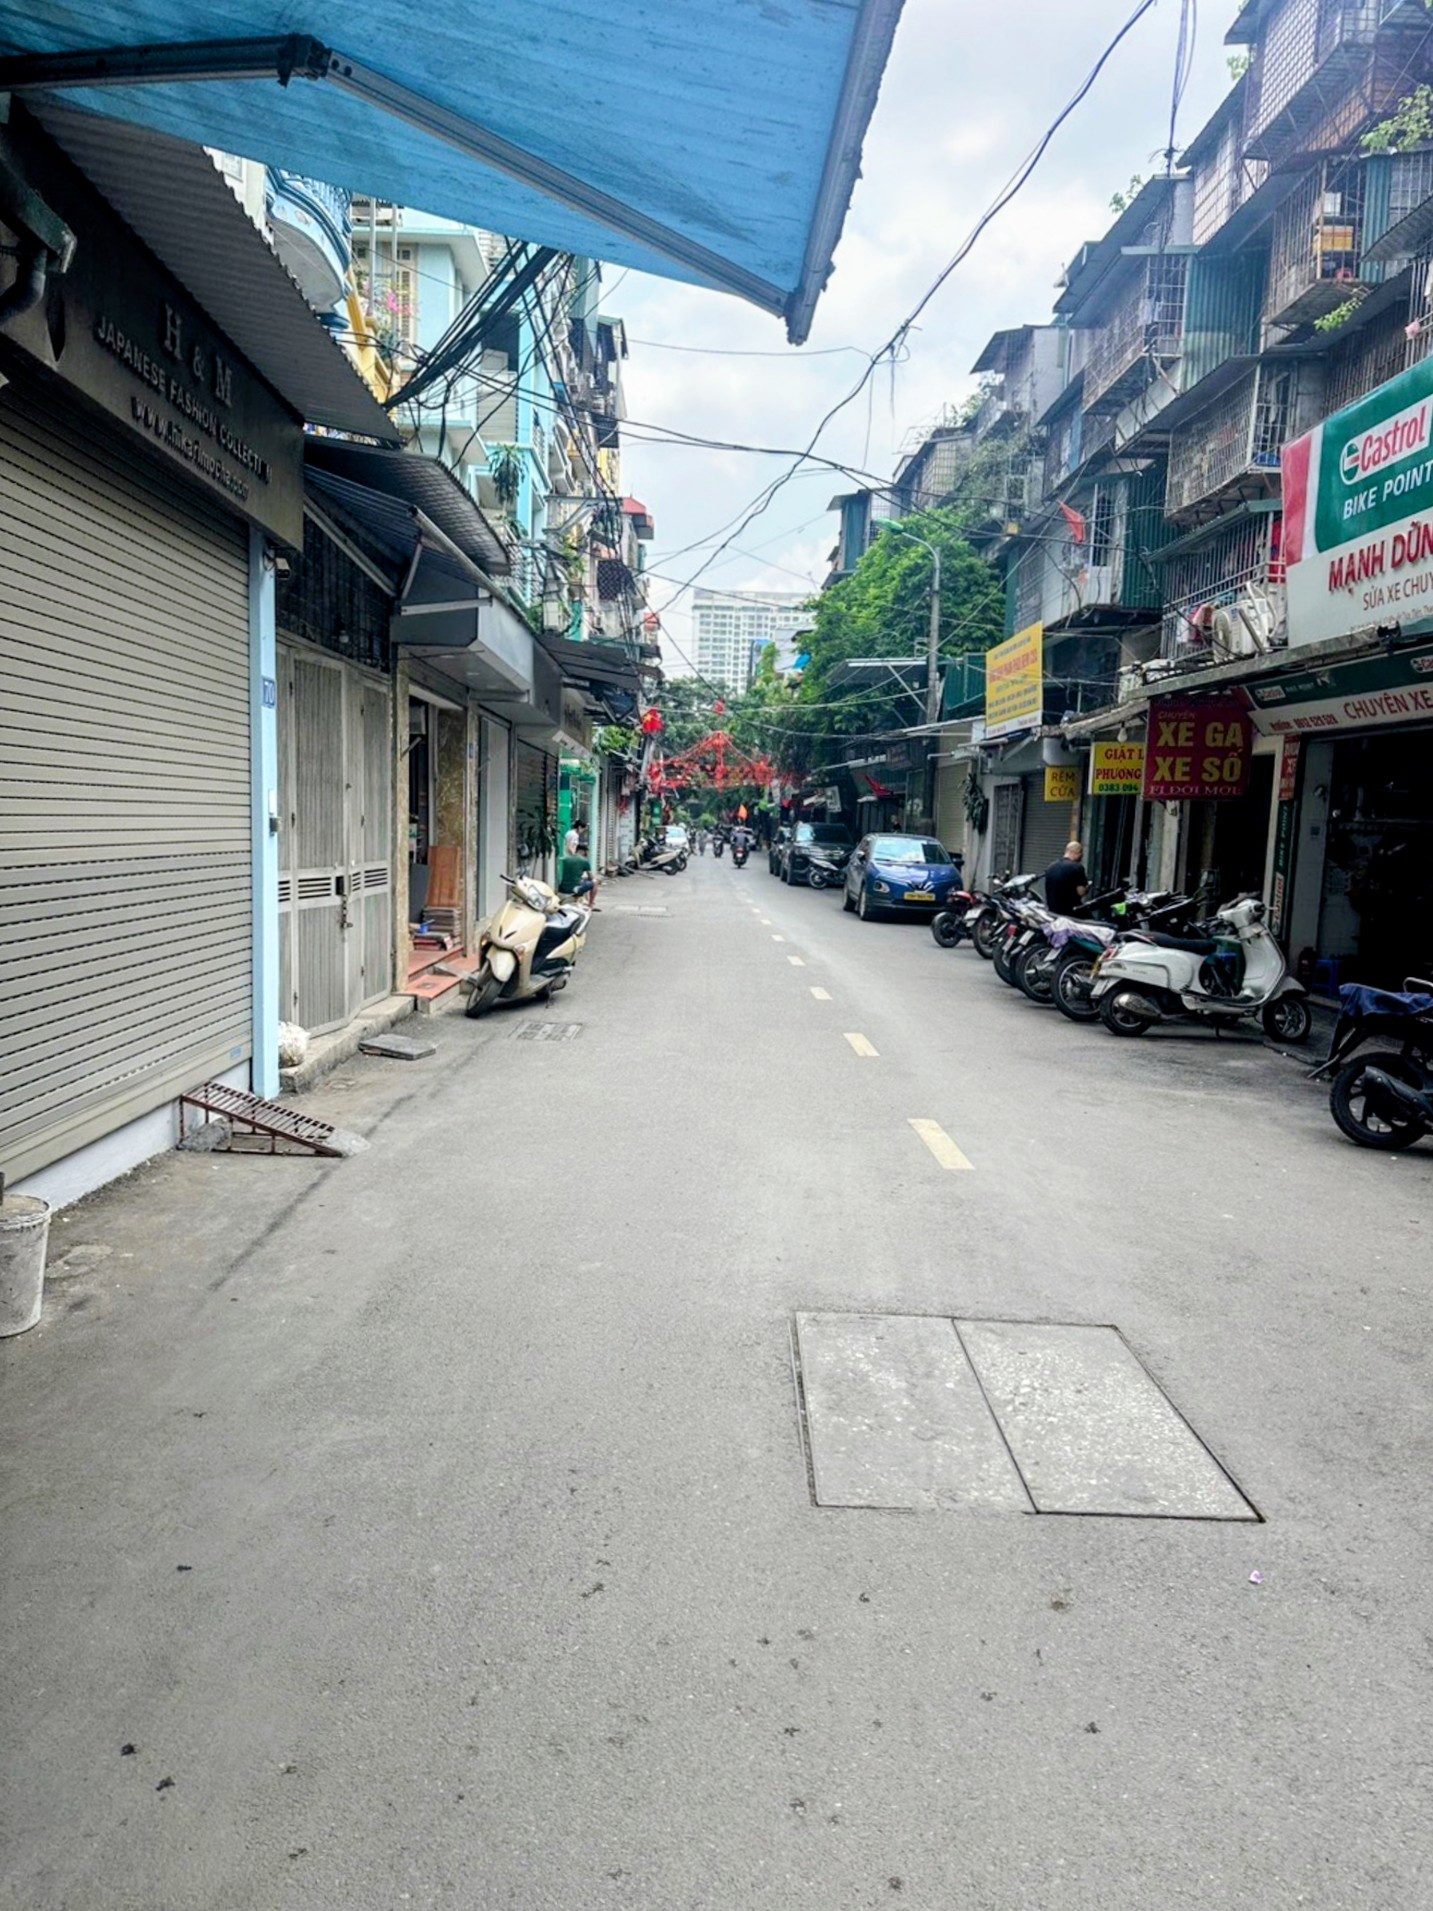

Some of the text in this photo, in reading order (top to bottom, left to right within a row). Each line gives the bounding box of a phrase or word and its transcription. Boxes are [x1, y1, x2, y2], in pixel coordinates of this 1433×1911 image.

[98, 316, 166, 392] JAPANESE
[169, 379, 217, 436] FASHION
[164, 303, 183, 361] H
[215, 356, 233, 409] M
[1361, 405, 1428, 472] Castrol
[1343, 459, 1433, 521] BIKE POINT
[1328, 540, 1386, 596] MẠNH
[1386, 582, 1401, 604] XE
[1343, 689, 1433, 720] CHUYÊN XE
[1157, 721, 1196, 747] XE
[1205, 721, 1244, 748] GA
[1153, 756, 1192, 782] XE
[1201, 749, 1243, 783] SỐ
